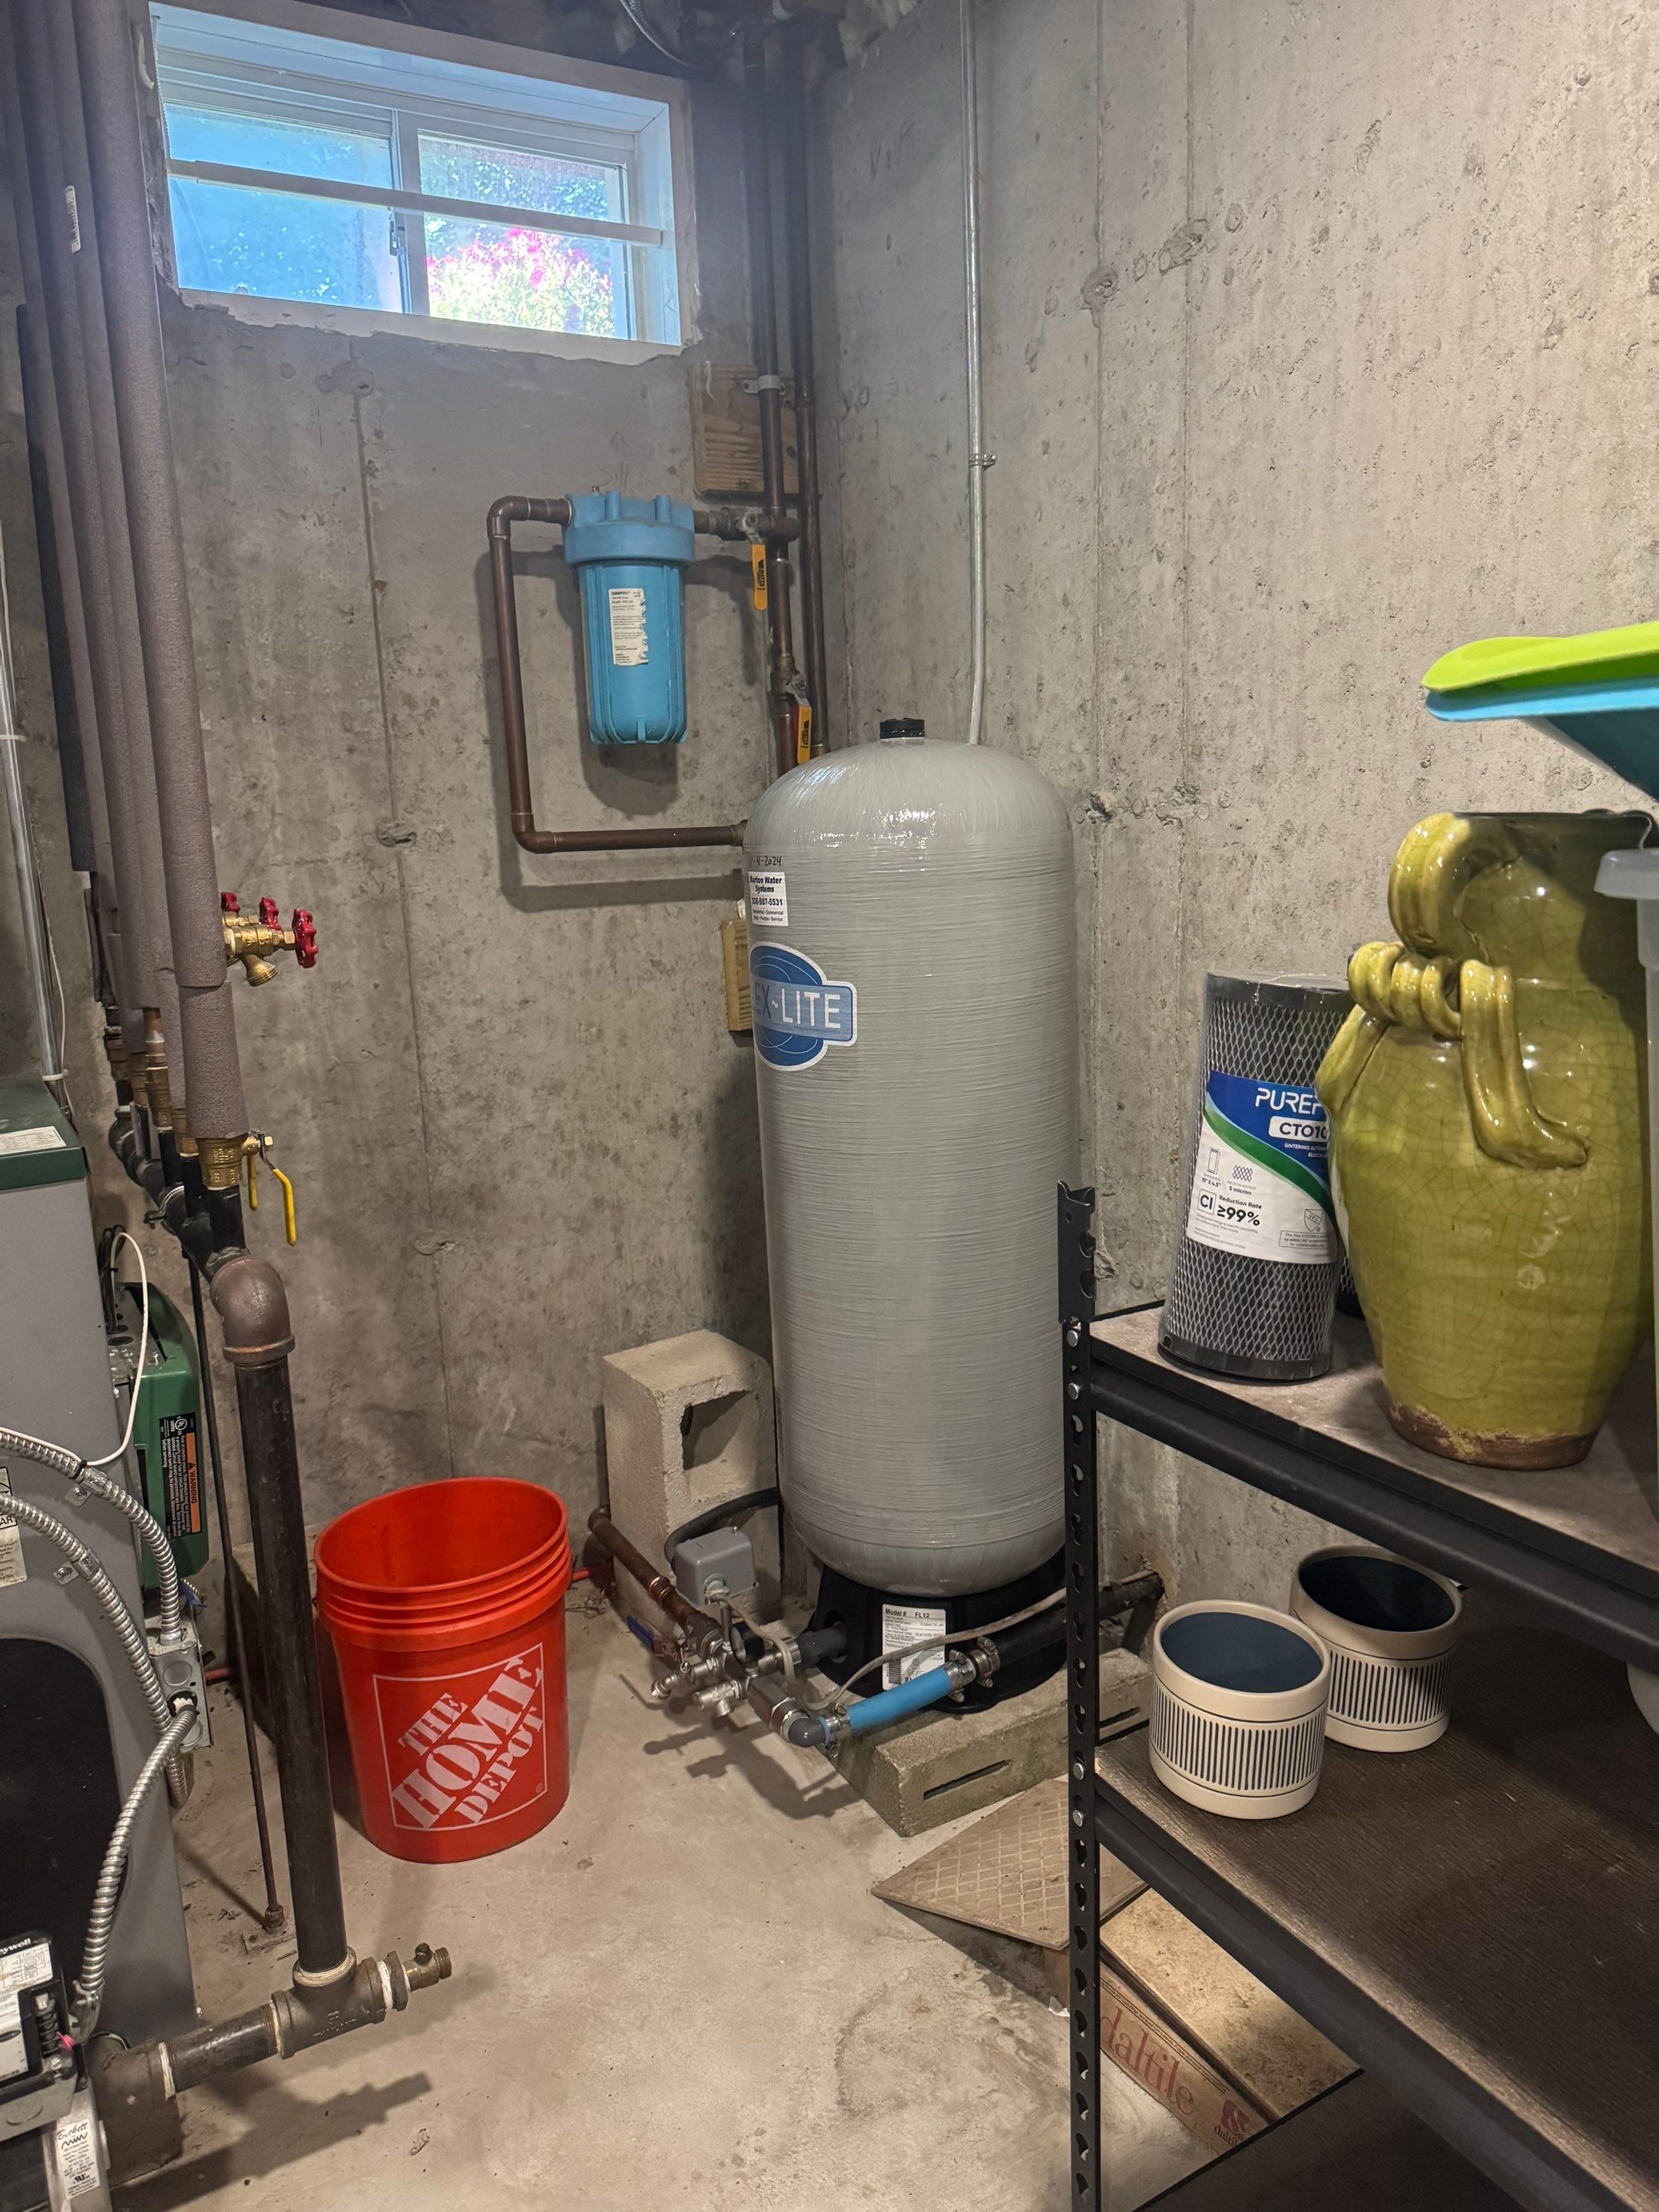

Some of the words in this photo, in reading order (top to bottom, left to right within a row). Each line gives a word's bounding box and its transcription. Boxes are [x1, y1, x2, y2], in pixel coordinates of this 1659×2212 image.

[755, 885, 774, 894] Systems
[1219, 1195, 1247, 1207] Reduction
[1233, 1187, 1252, 1195] micron
[391, 1657, 543, 1828] HOME
[398, 1693, 469, 1757] THE
[454, 1706, 543, 1823] DEPOT
[1100, 2006, 1194, 2115] daltile
